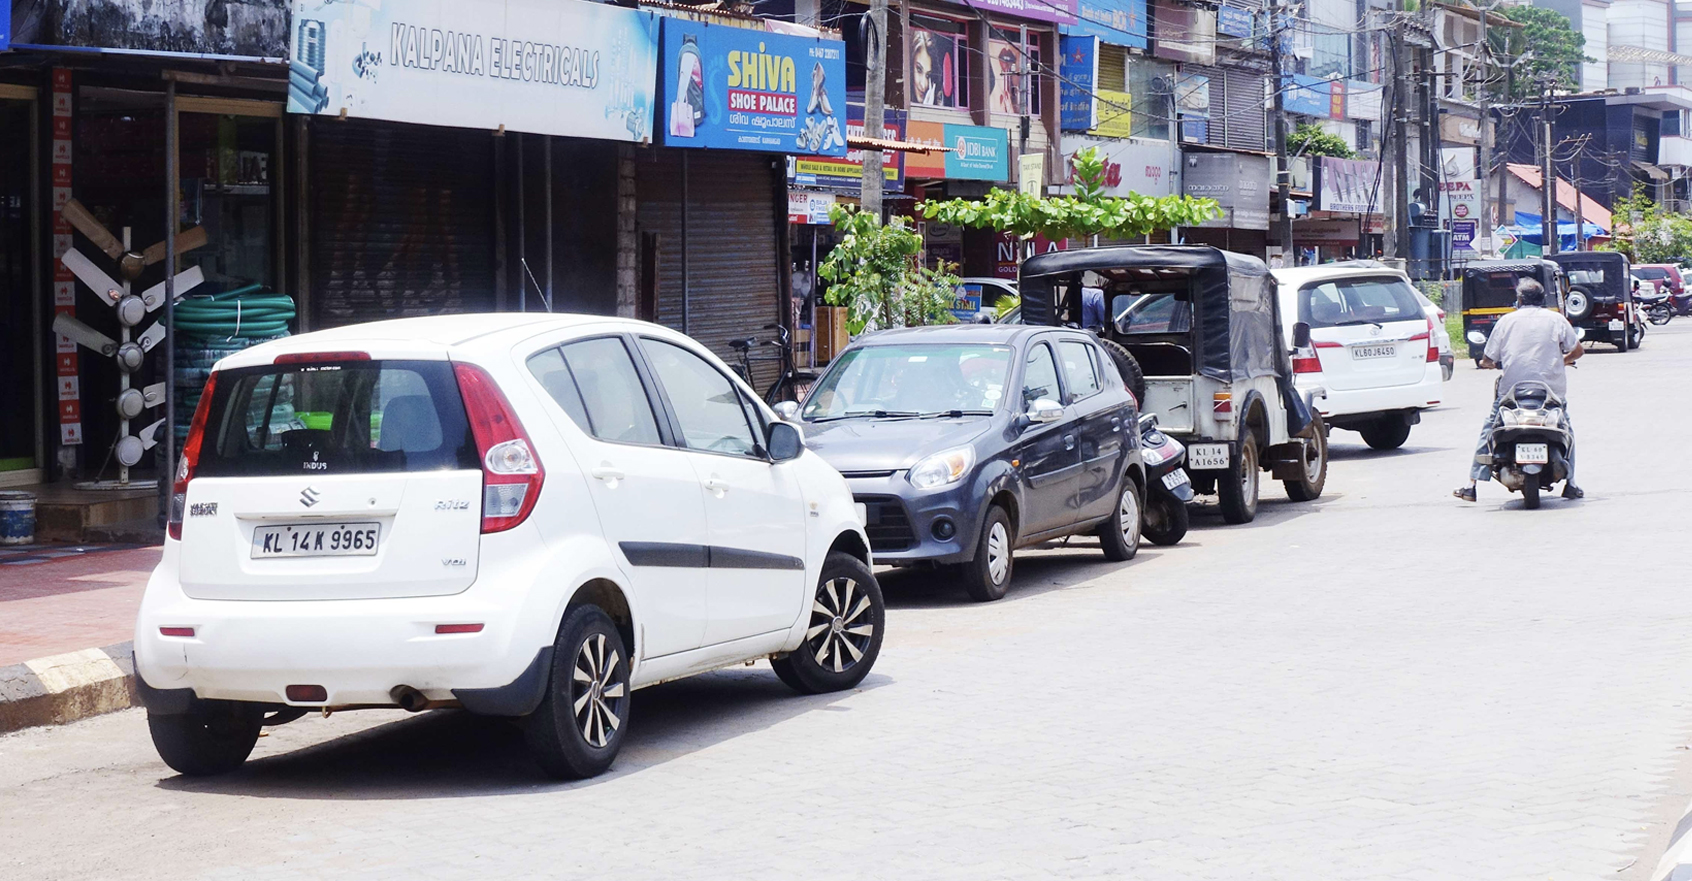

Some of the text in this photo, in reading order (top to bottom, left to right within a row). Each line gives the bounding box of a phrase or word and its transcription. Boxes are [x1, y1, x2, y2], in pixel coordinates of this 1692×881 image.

[390, 22, 600, 89] KALPANA ELECTRICALS
[730, 92, 796, 114] SHOE PALACE
[967, 141, 997, 157] IDBI BANK
[1330, 203, 1354, 211] BROTHERS
[1212, 447, 1222, 456] 14
[303, 461, 327, 470] INDUS
[1195, 457, 1225, 467] A1656
[434, 498, 470, 511] Ritz
[262, 530, 376, 553] KL 14 K 9965
